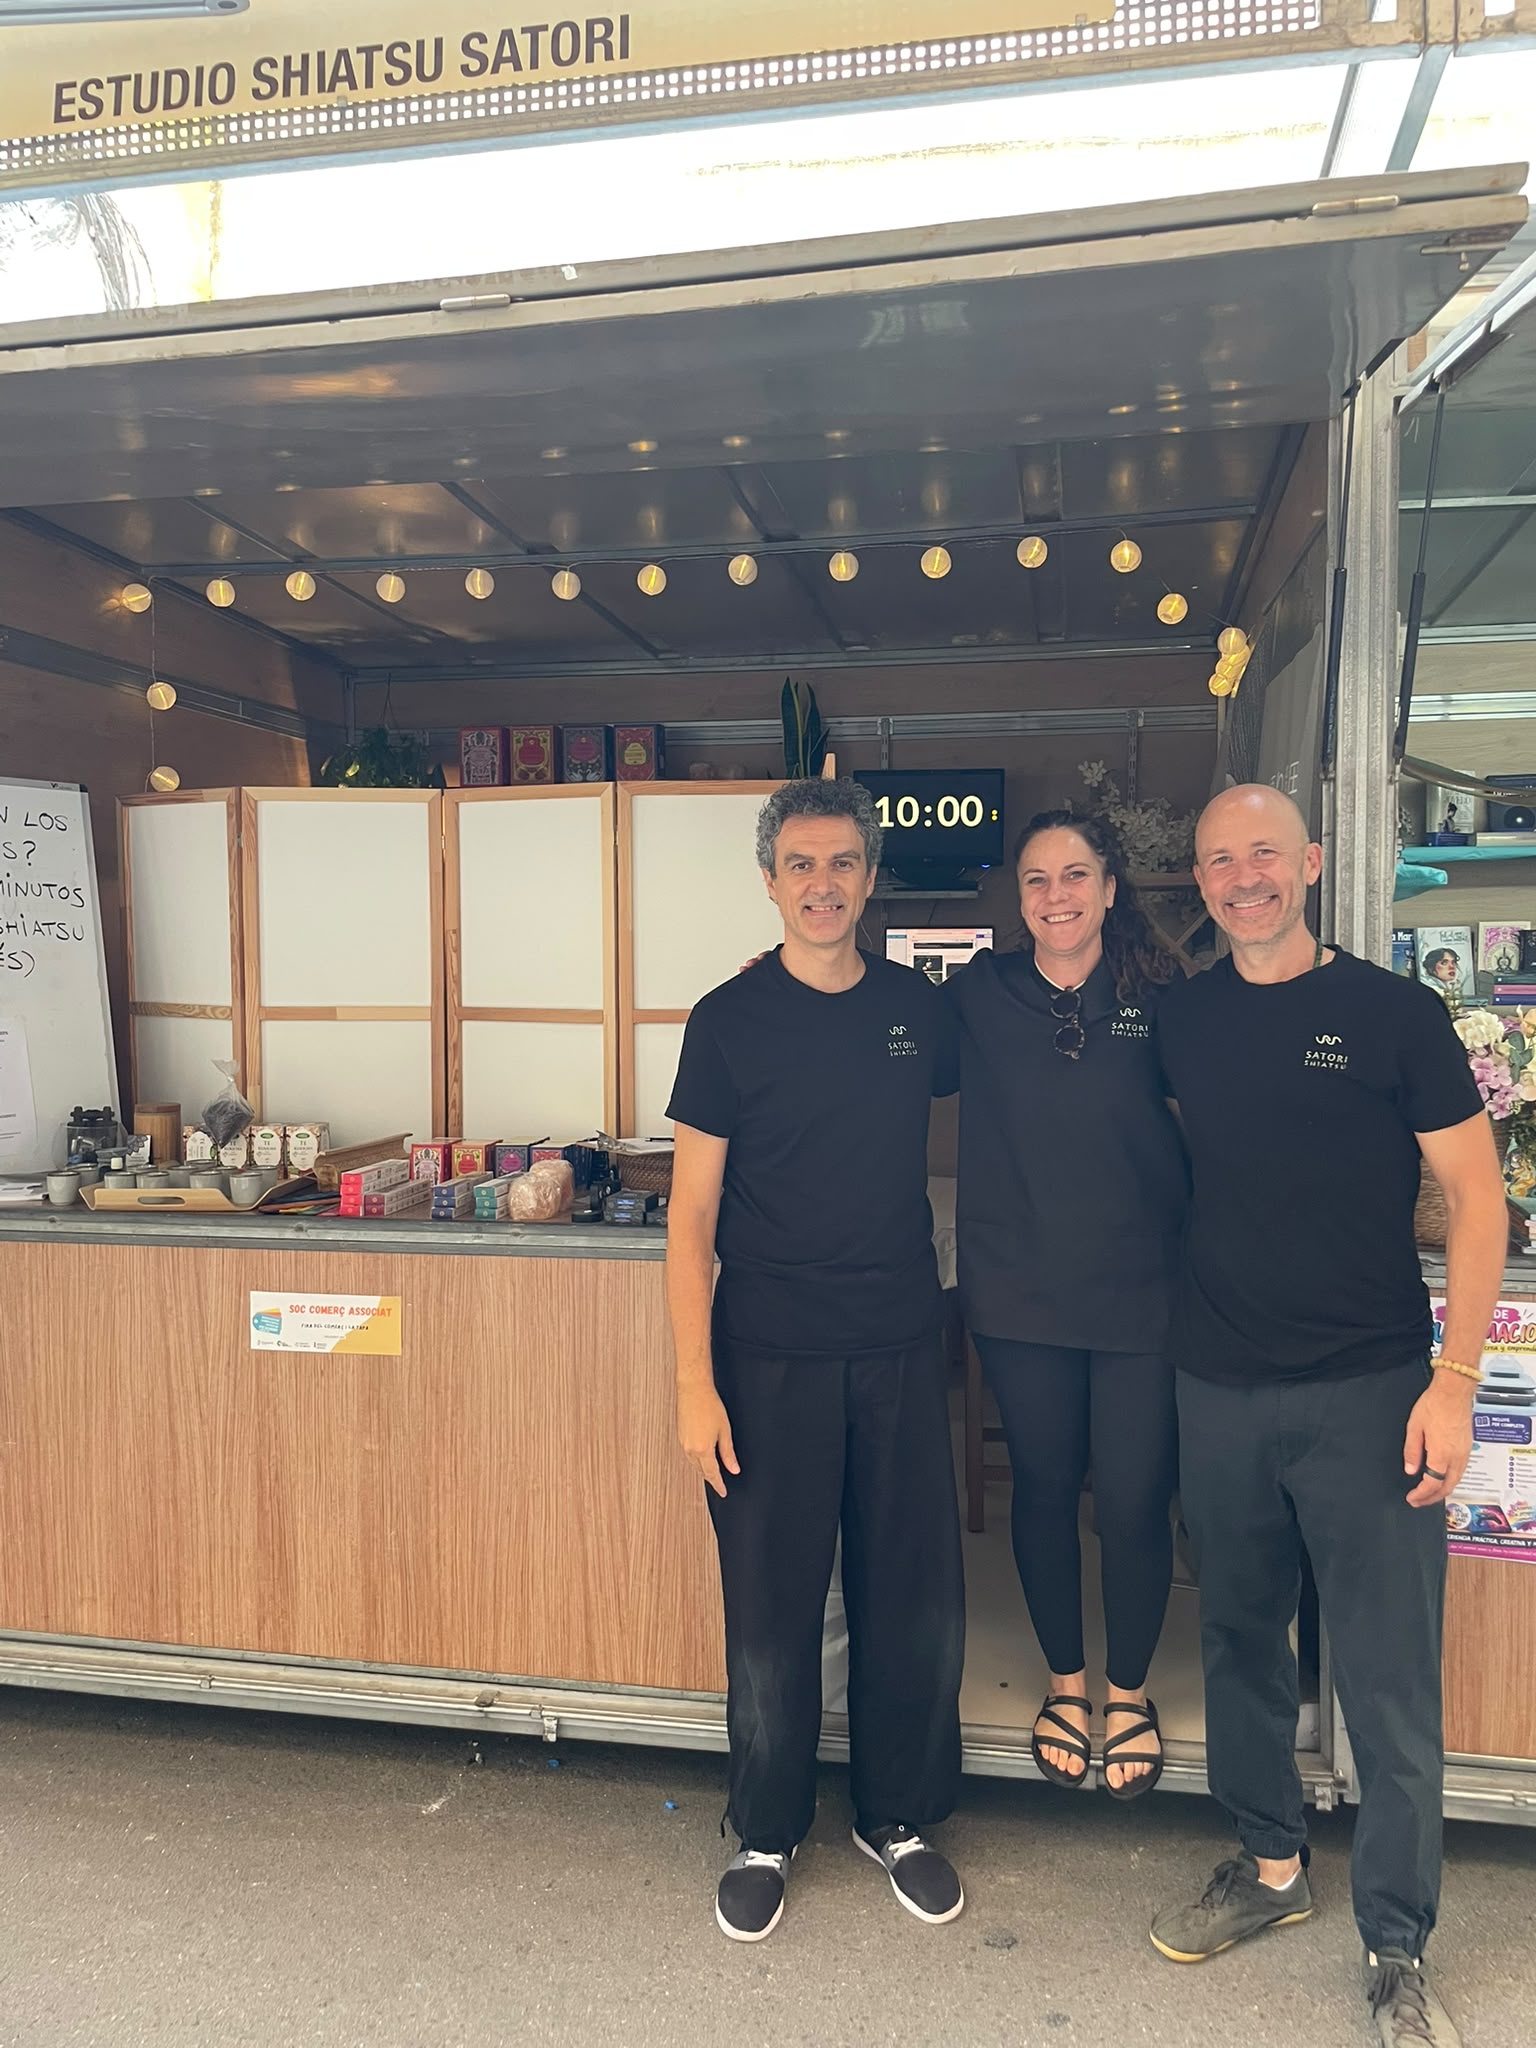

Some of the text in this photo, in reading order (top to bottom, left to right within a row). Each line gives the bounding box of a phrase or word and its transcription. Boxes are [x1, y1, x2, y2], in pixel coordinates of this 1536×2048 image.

[53, 14, 630, 124] ESTUDIO SHIATSU SATORI
[875, 795, 984, 828] 10:00
[24, 811, 69, 831] LOS
[1112, 1022, 1149, 1032] SATORI
[1111, 1030, 1149, 1038] SHIATSU
[888, 1041, 916, 1050] SATORI
[1305, 1050, 1348, 1063] SATORI
[1304, 1060, 1347, 1070] SHIATSU
[289, 1304, 392, 1317] SOC COMERÇ ASSOCIAT
[1493, 1309, 1509, 1320] DE
